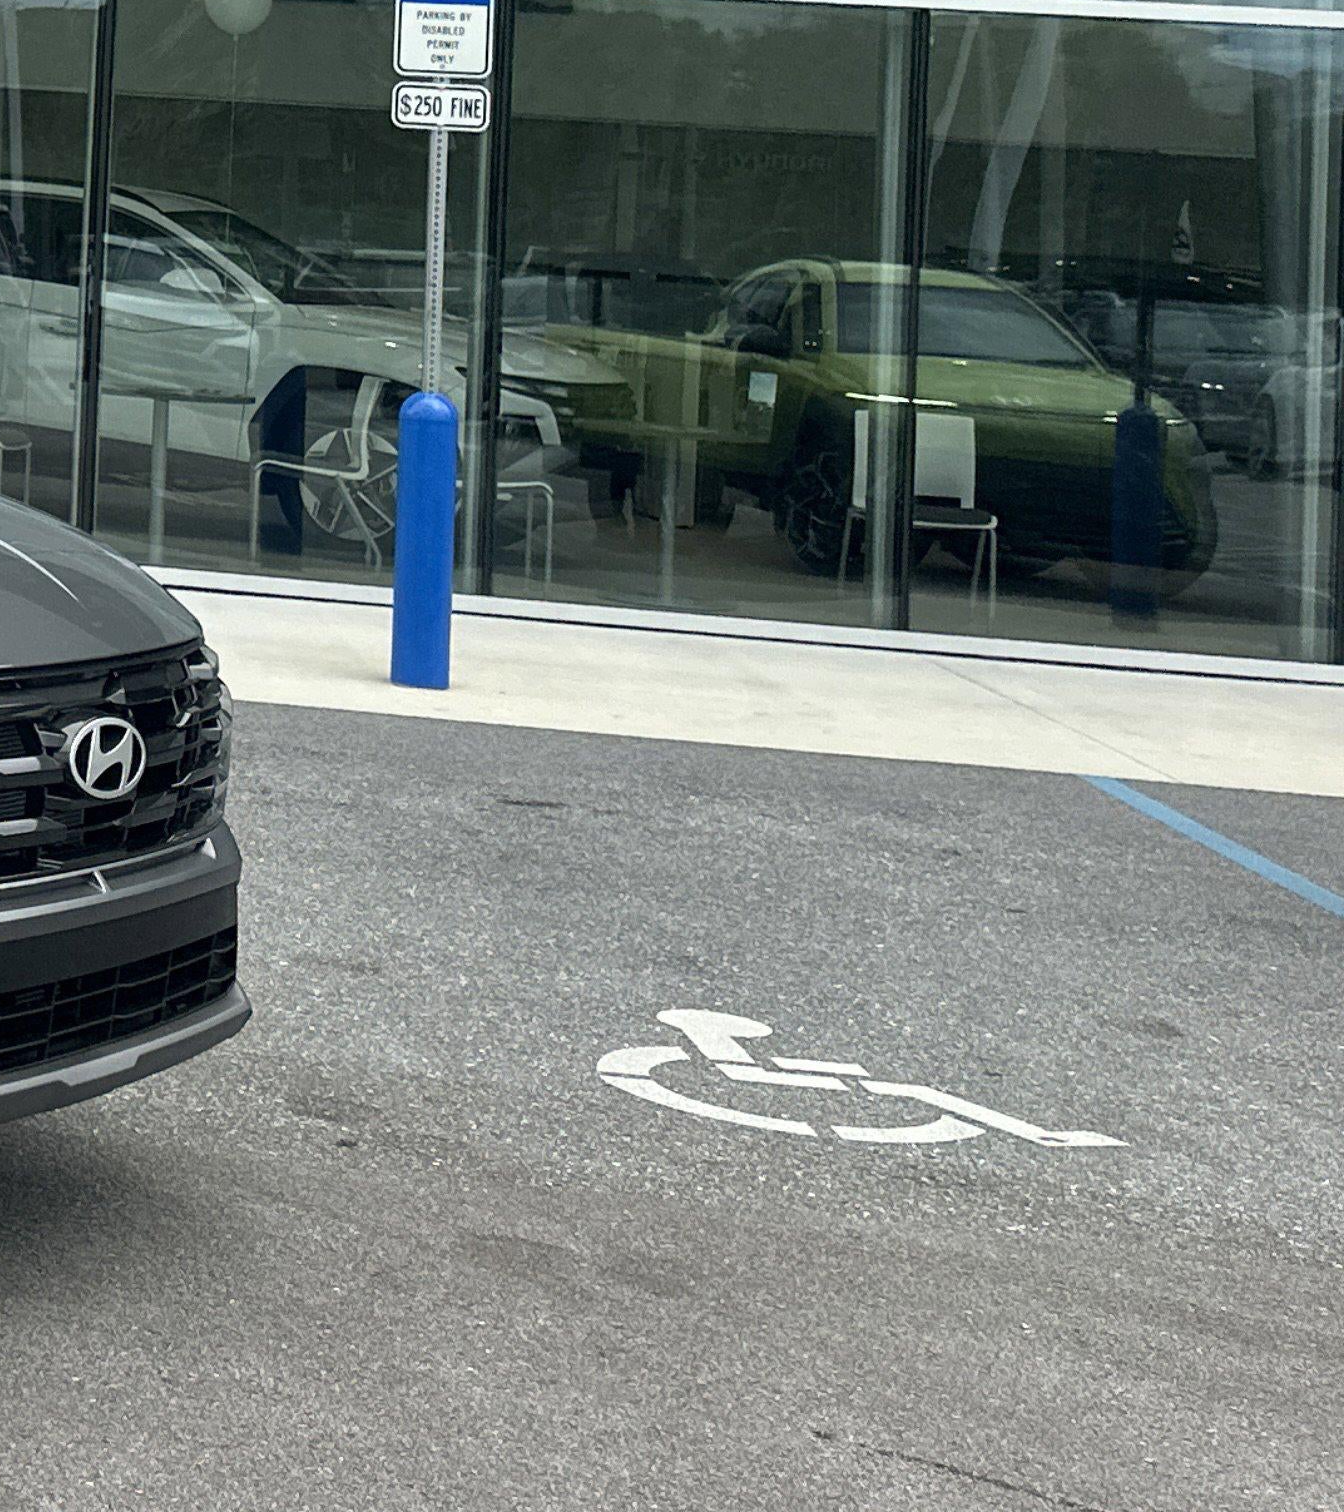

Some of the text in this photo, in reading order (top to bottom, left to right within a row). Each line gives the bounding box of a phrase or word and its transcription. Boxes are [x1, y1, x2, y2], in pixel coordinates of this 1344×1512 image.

[416, 10, 472, 22] PARKING BY
[422, 25, 465, 36] DISABLED
[427, 39, 460, 49] PERMIT
[430, 53, 455, 64] ONLY
[400, 94, 482, 119] $250 FINE
